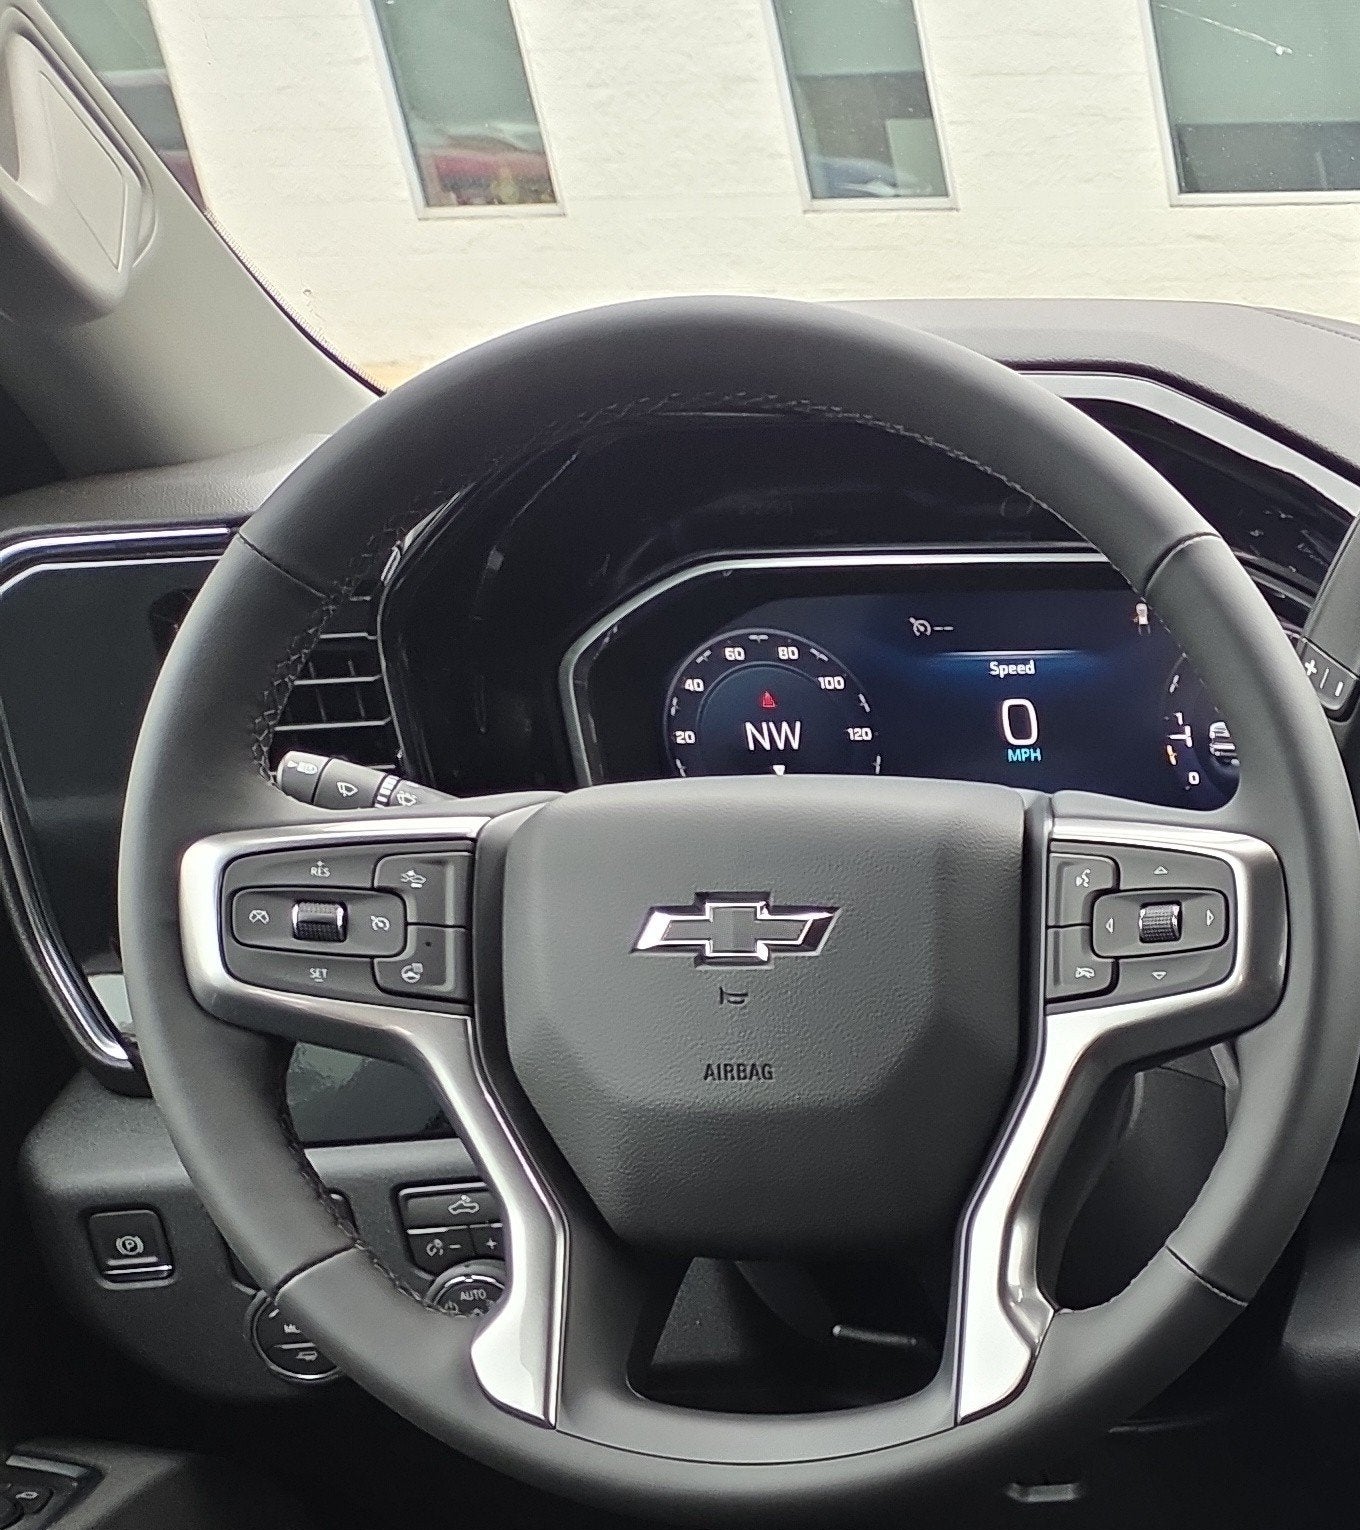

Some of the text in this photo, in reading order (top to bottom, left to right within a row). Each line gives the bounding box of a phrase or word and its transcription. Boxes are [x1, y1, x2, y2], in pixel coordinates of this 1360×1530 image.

[724, 647, 746, 661] 60
[777, 646, 799, 660] 80
[989, 659, 1036, 678] Speed
[684, 678, 704, 691] 40
[817, 676, 845, 690] 100
[1001, 698, 1038, 746] 0
[675, 730, 695, 744] 20
[744, 720, 802, 751] NW
[847, 727, 873, 741] 120
[1007, 748, 1042, 762] MPH
[310, 866, 331, 878] RES
[310, 967, 328, 979] SET
[703, 1062, 774, 1080] AIRBAG
[460, 1289, 486, 1301] AUTO
